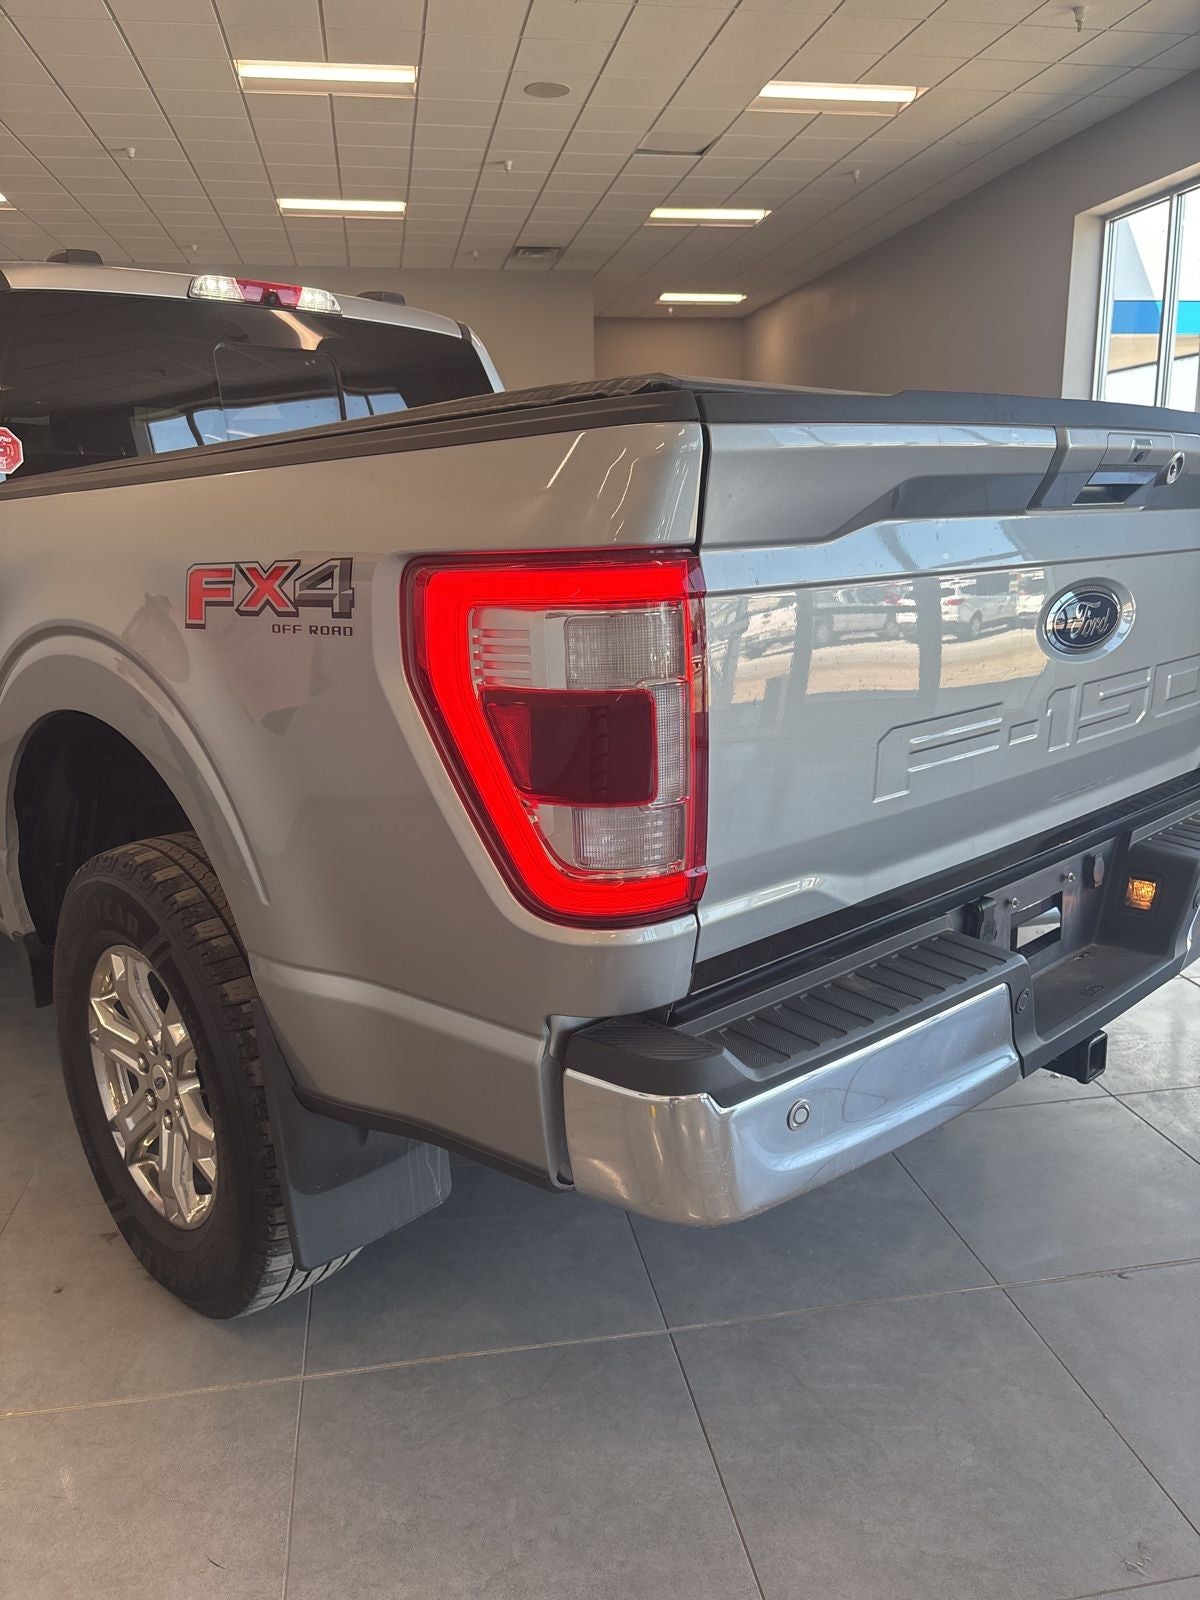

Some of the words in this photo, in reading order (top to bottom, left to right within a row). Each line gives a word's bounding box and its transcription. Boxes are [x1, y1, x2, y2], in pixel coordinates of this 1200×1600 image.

[184, 557, 355, 630] FX4
[1069, 600, 1111, 640] Ford
[271, 623, 302, 634] OFF
[308, 624, 353, 637] ROAD
[873, 653, 1200, 803] F-150
